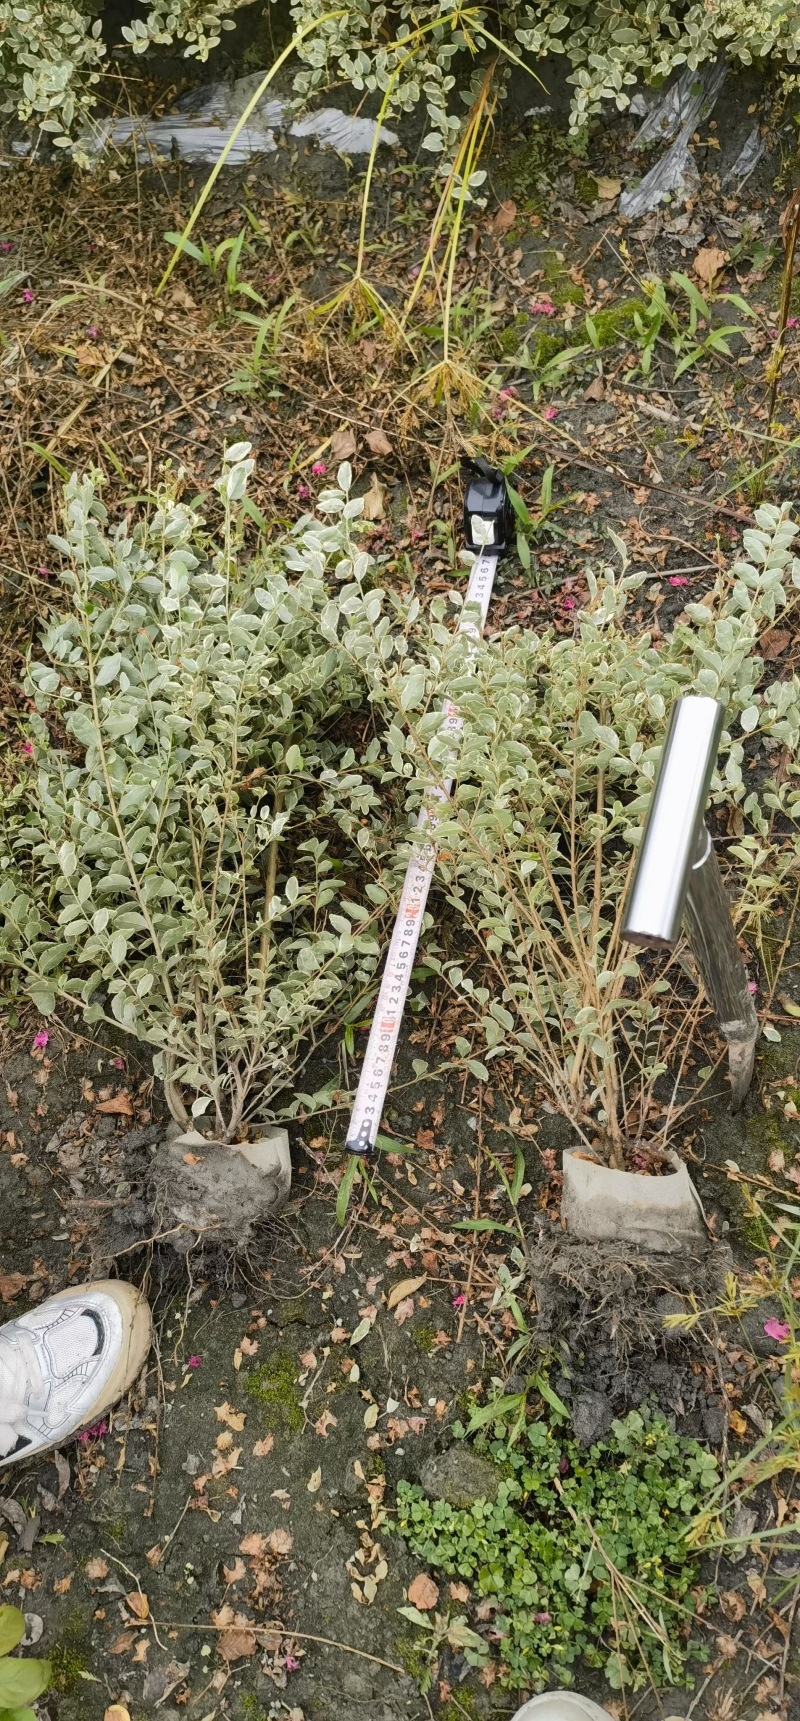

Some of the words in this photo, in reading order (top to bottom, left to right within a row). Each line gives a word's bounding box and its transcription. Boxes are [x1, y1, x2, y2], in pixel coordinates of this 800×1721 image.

[403, 929, 414, 937] 8
[399, 951, 409, 959] 6
[381, 1033, 391, 1041] 9
[378, 1044, 389, 1052] 8
[373, 1069, 383, 1077] 6
[370, 1081, 381, 1089] 5
[368, 1094, 378, 1102] 4
[365, 1106, 375, 1115] 3
